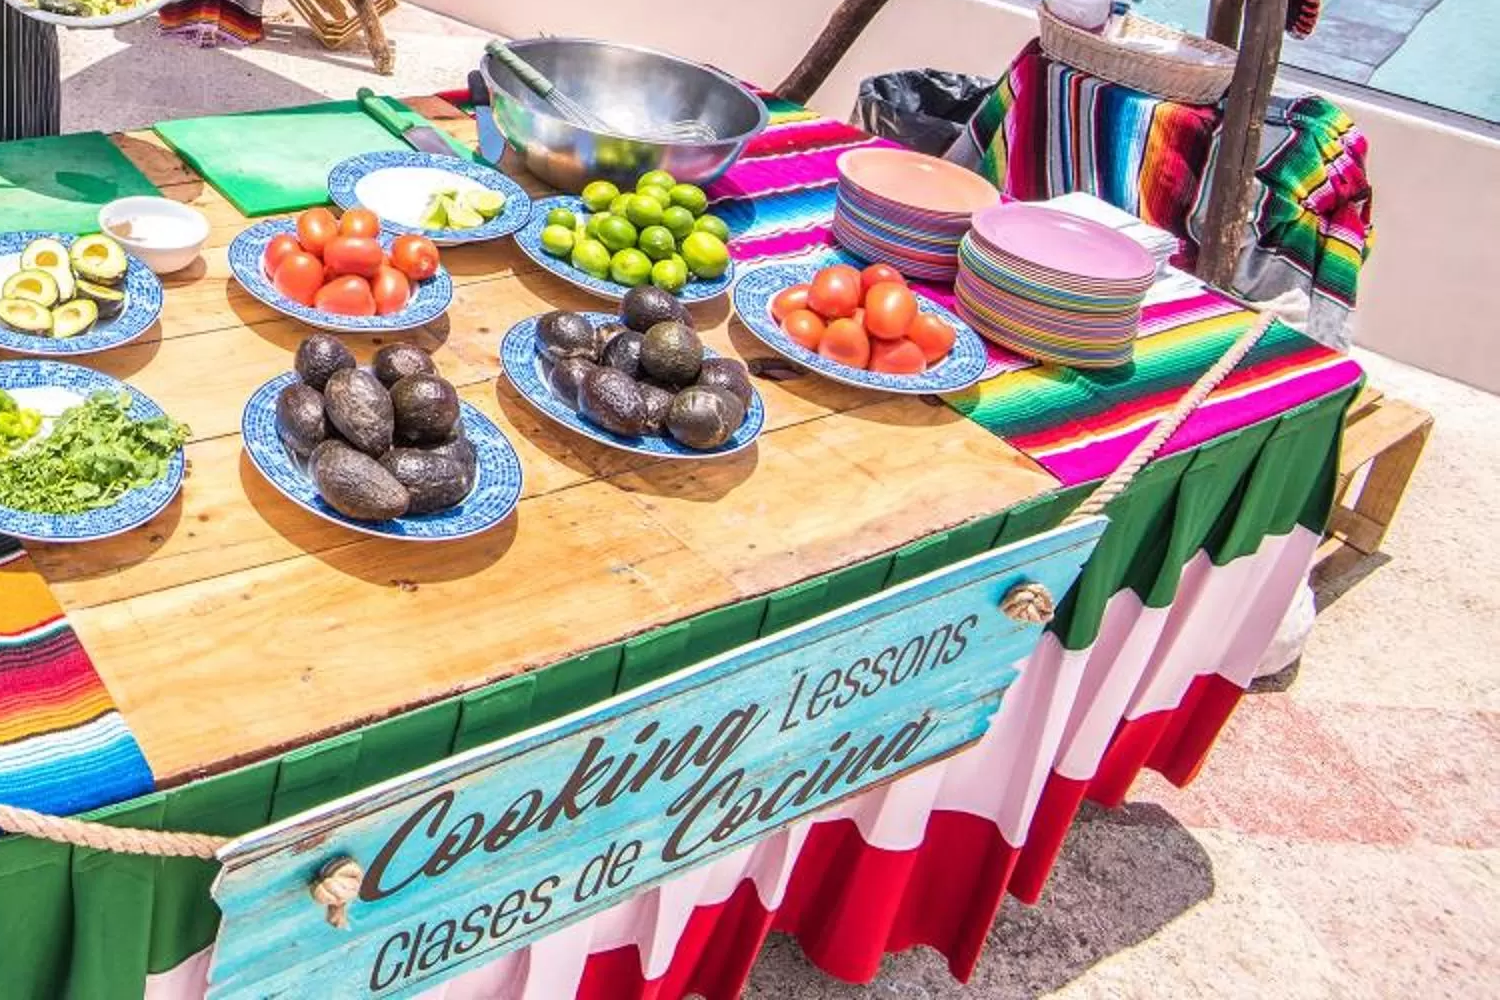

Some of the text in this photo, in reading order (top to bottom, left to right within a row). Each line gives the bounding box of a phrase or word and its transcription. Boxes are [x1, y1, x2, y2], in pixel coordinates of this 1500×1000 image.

[359, 614, 978, 902] Cooking Lessons
[574, 839, 642, 902] de
[661, 715, 940, 863] Cocina
